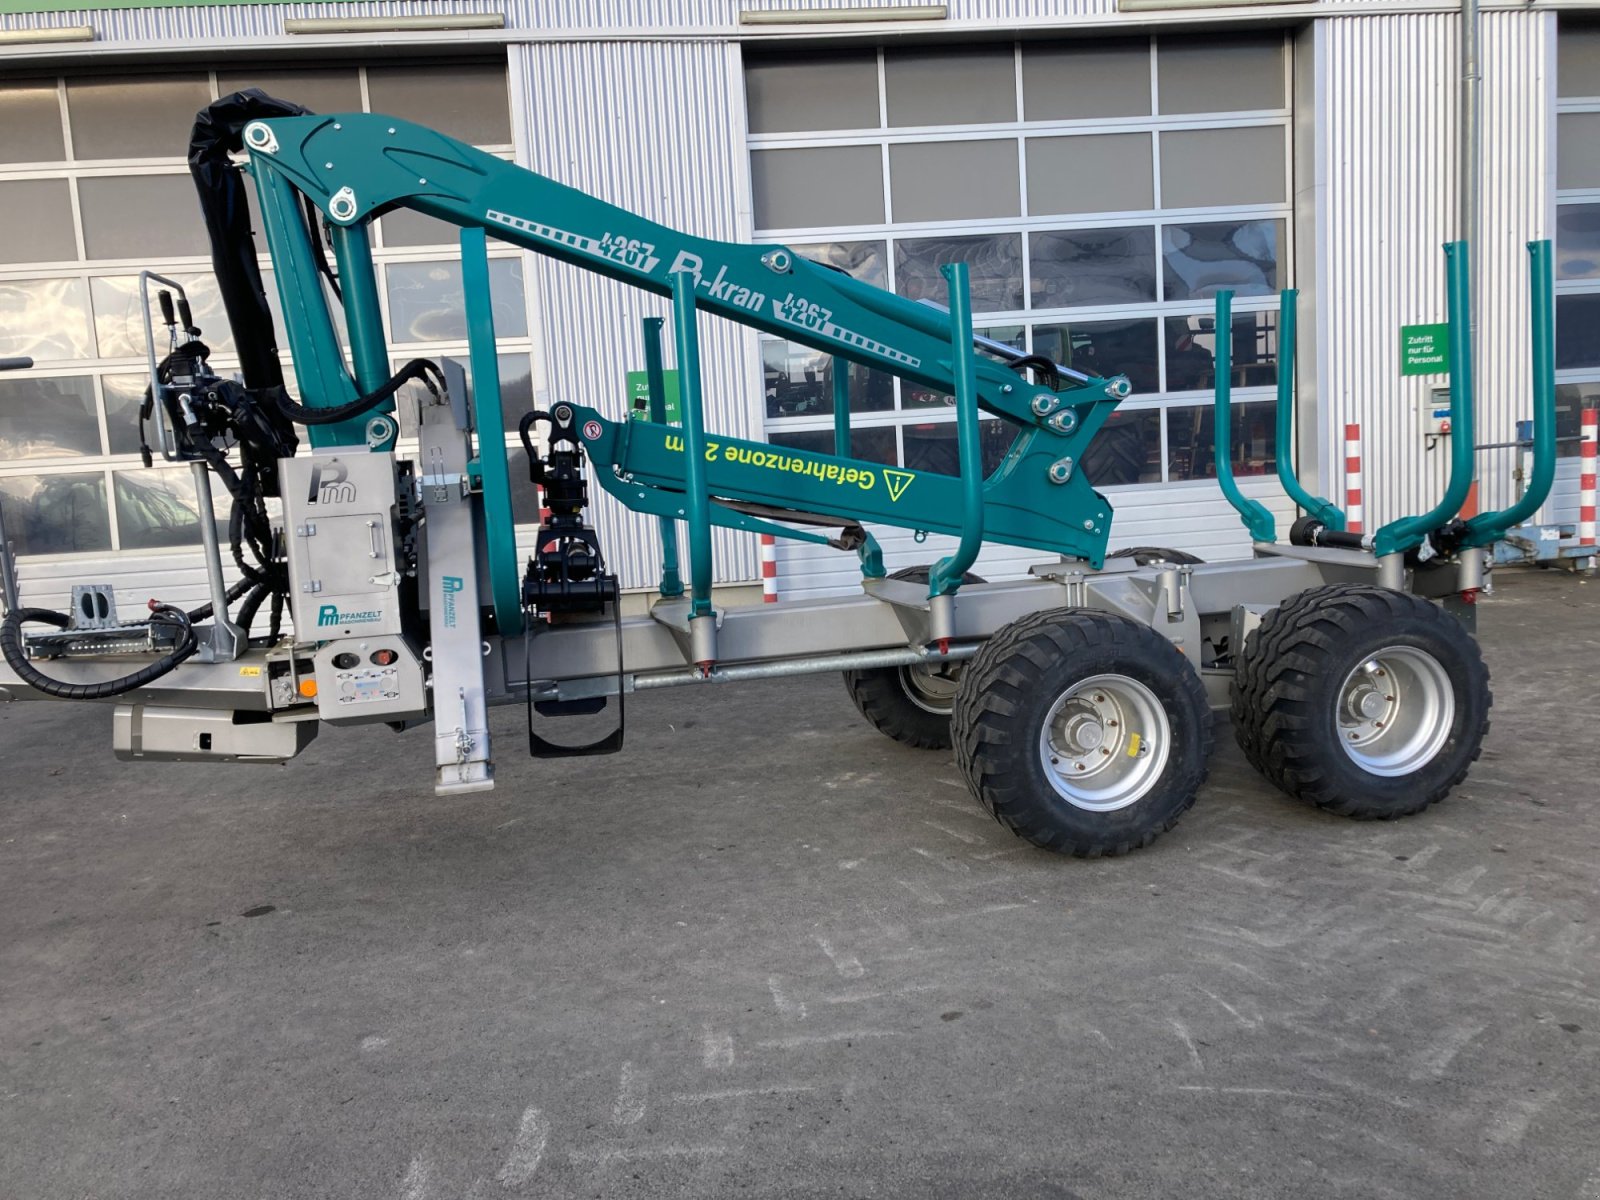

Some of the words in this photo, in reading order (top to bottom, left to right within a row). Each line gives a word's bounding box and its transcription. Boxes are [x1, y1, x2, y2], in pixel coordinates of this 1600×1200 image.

[598, 232, 656, 270] 4267
[780, 292, 833, 332] 4267
[1408, 336, 1433, 344] Zutritt
[1423, 345, 1434, 353] für
[1408, 355, 1443, 364] Personal
[725, 446, 876, 490] Gefahrenzone
[340, 610, 383, 620] PFANZELT
